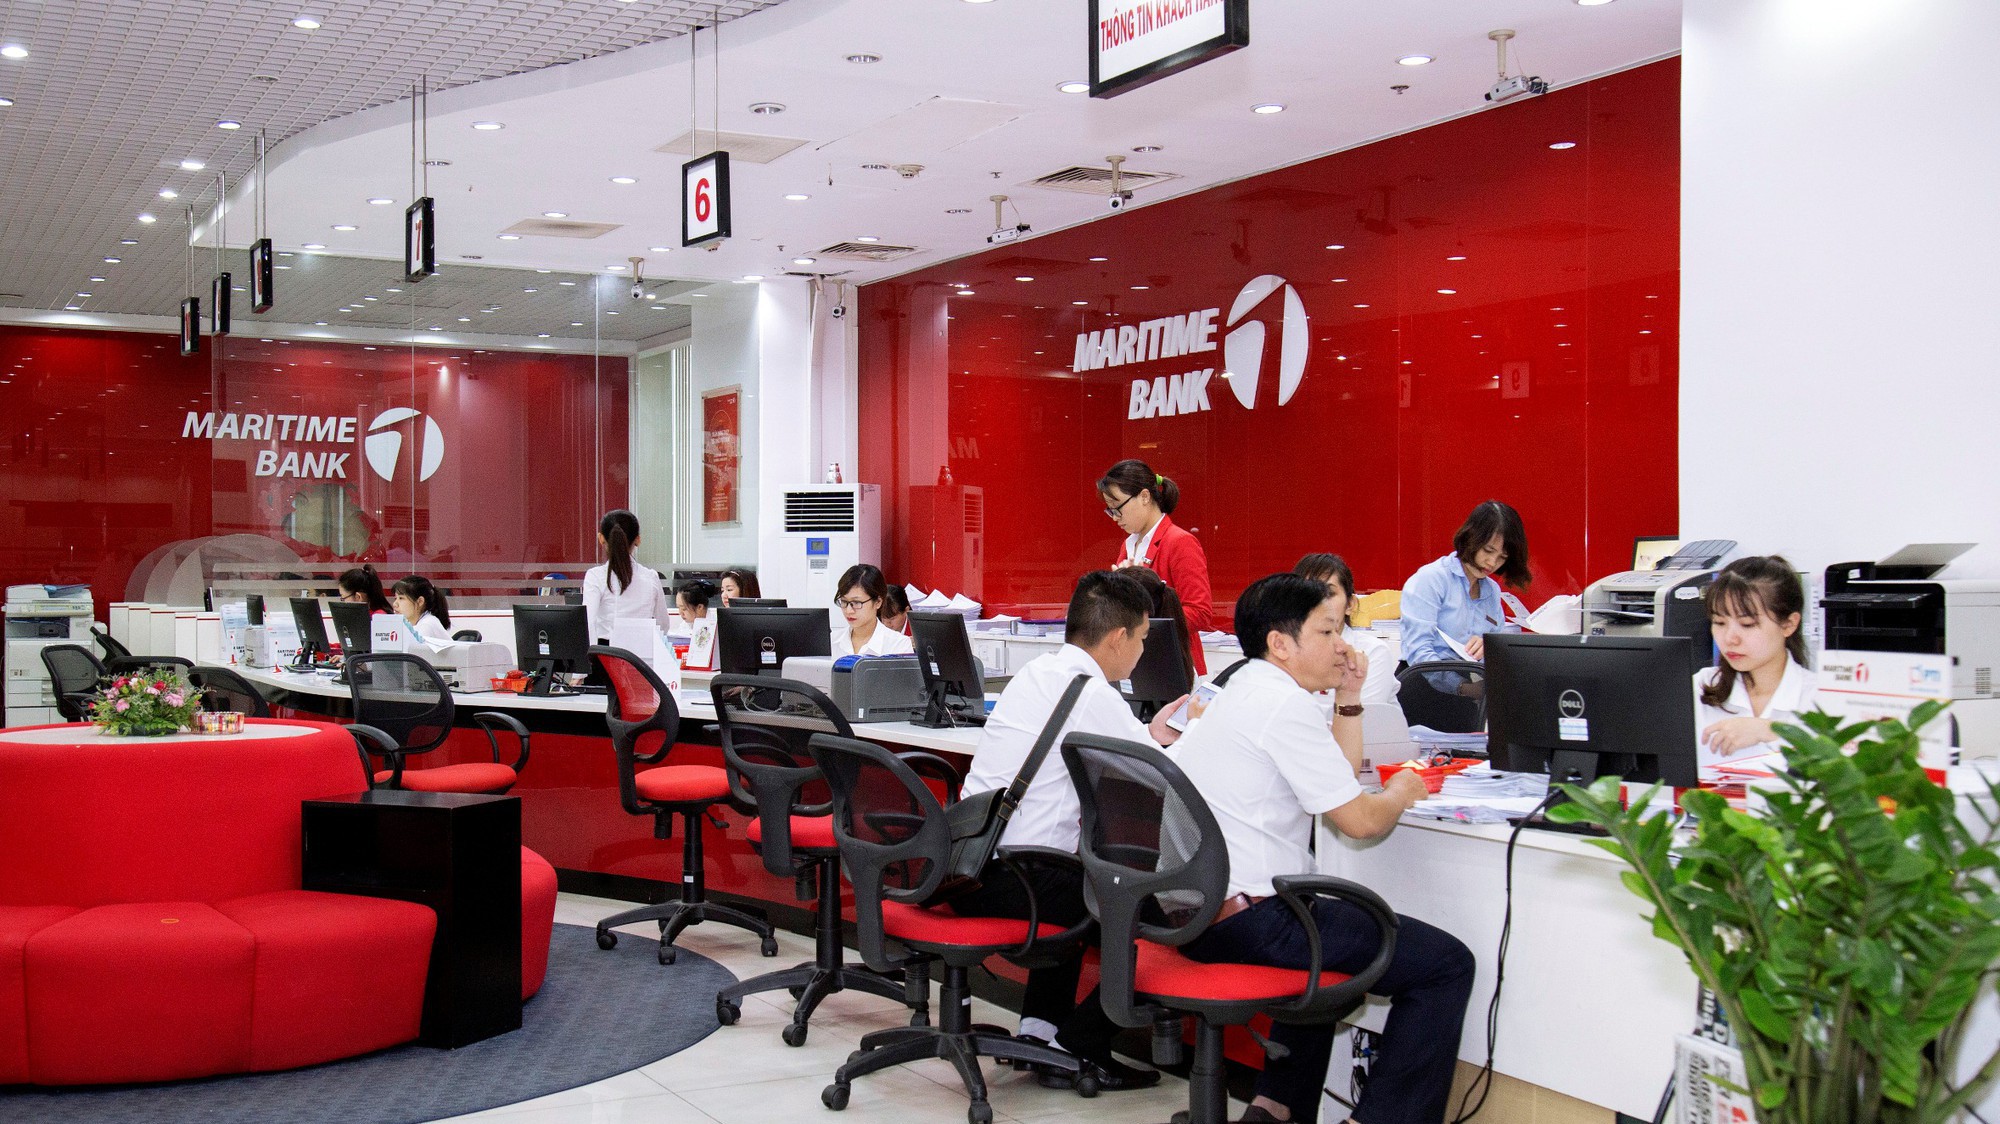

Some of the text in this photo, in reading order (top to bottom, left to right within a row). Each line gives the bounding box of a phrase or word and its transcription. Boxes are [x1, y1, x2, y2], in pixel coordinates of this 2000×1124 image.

[1101, 8, 1135, 51] THÔNG
[1137, 1, 1153, 36] TIN
[695, 178, 711, 222] 6
[1073, 307, 1220, 373] MARITIME
[1128, 368, 1215, 420] BANK
[182, 412, 357, 443] MARITIME
[255, 450, 350, 479] BANK
[1562, 699, 1582, 709] DELL
